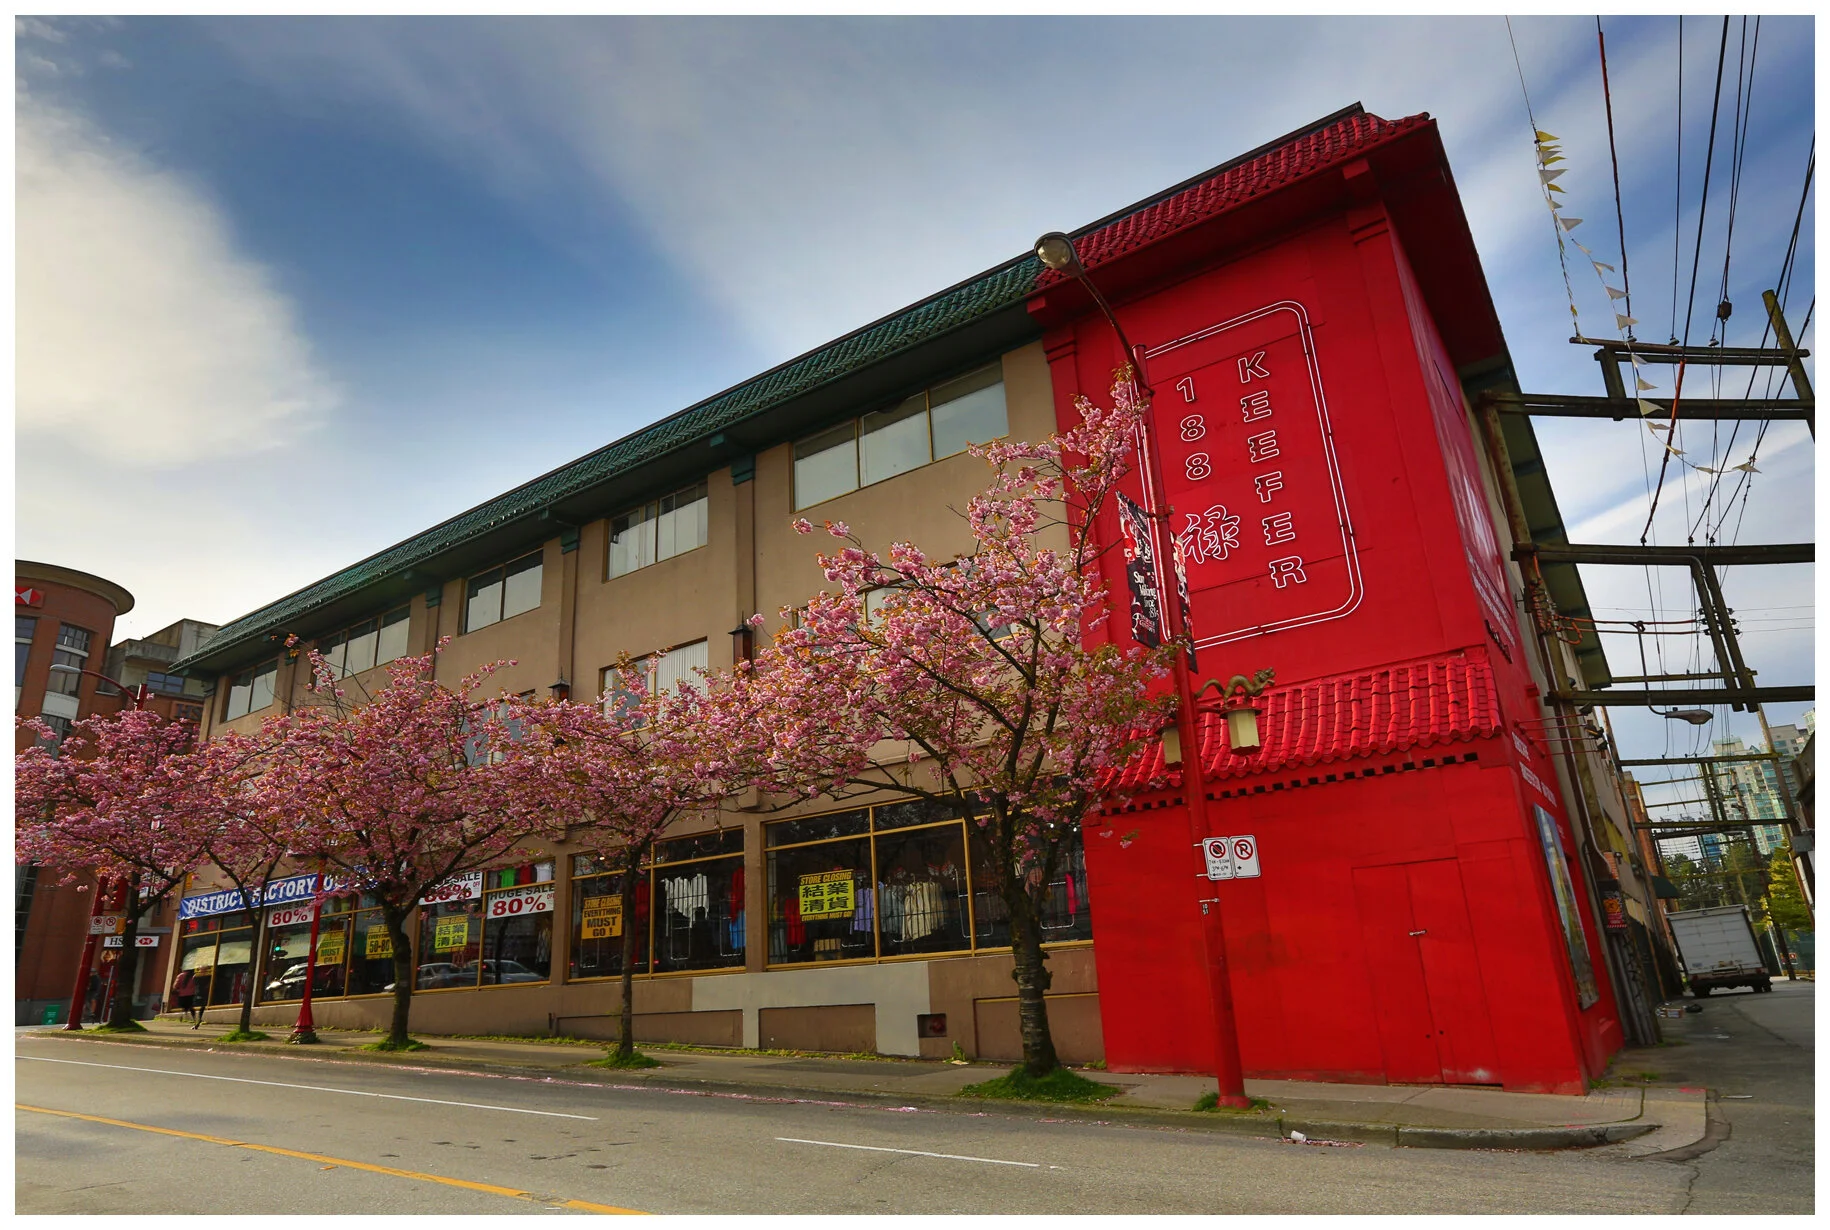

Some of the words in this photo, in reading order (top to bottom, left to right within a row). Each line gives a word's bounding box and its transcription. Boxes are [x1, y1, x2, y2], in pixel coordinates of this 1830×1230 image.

[1176, 376, 1212, 481] 188
[1237, 351, 1307, 589] KEEFER
[801, 875, 821, 885] STORE
[823, 871, 851, 882] CLOSING
[489, 888, 522, 900] HUGE
[525, 883, 555, 895] SALE
[492, 895, 547, 916] 80%
[272, 910, 308, 926] 80%
[587, 917, 617, 928] MUST
